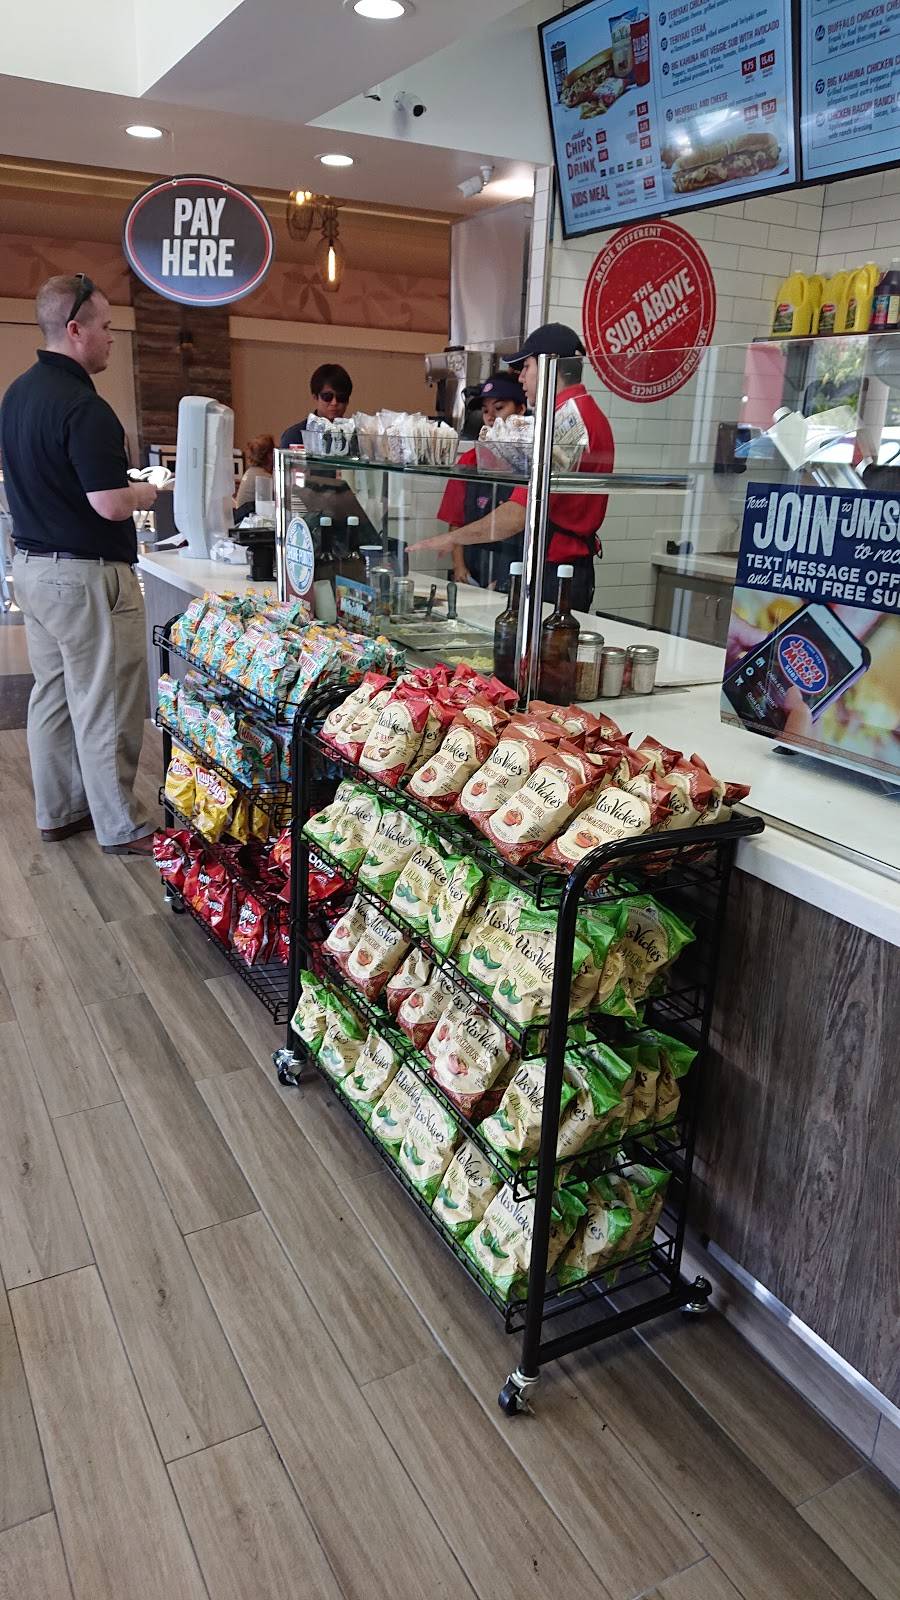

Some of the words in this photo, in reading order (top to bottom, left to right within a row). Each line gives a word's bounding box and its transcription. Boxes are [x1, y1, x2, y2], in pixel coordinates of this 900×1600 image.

[856, 4, 884, 23] CHICKEN
[669, 31, 690, 45] TERIYAKI
[691, 23, 706, 36] STEAK
[671, 60, 680, 71] BIG
[679, 54, 700, 69] KAHUNA
[700, 50, 710, 60] HOT
[739, 30, 754, 44] WITH
[754, 19, 780, 39] AVOCADO
[838, 67, 865, 83] KAHUNA
[866, 58, 894, 75] CHICKEN
[699, 98, 710, 108] AND
[710, 92, 728, 105] CHEESE
[852, 101, 873, 117] BACON
[874, 94, 896, 108] RANCH
[566, 136, 592, 158] CHIPS
[568, 158, 597, 180] DRINK
[570, 189, 588, 209] KIDS
[588, 184, 610, 204] MEAL
[173, 197, 227, 237] PAY
[161, 238, 236, 278] HERE
[595, 248, 617, 283] MADE
[614, 227, 662, 251] DIFFERENT
[632, 281, 654, 303] THE
[605, 310, 643, 354] SUB
[641, 267, 696, 328] ABOVE
[626, 302, 690, 360] DIFFERENCE
[630, 372, 684, 395] DIFFERENCES
[752, 491, 840, 558] JOIN
[840, 502, 852, 512] to
[854, 542, 872, 560] to
[746, 552, 782, 572] TEXT
[786, 558, 860, 583] MESSAGE
[747, 570, 772, 586] and
[772, 572, 816, 594] EARN
[821, 580, 867, 603] FREE
[781, 646, 814, 689] Mike's
[784, 664, 800, 682] SUBS
[790, 639, 824, 683] Jersey
[536, 777, 563, 811] Vickie's
[533, 804, 545, 820] BBQ
[581, 814, 616, 834] SMOKEHOUSE
[608, 798, 642, 829] Vickie's
[384, 823, 414, 849] Vickie's
[308, 852, 335, 878] Doritos
[424, 855, 448, 887] Vickie
[632, 922, 664, 964] Vickie's
[516, 934, 538, 962] Miss
[534, 946, 554, 984] Vickie
[432, 990, 444, 1005] BBQ
[462, 1017, 480, 1040] Miss
[396, 1070, 410, 1092] Miss
[464, 1152, 486, 1188] Vickie's
